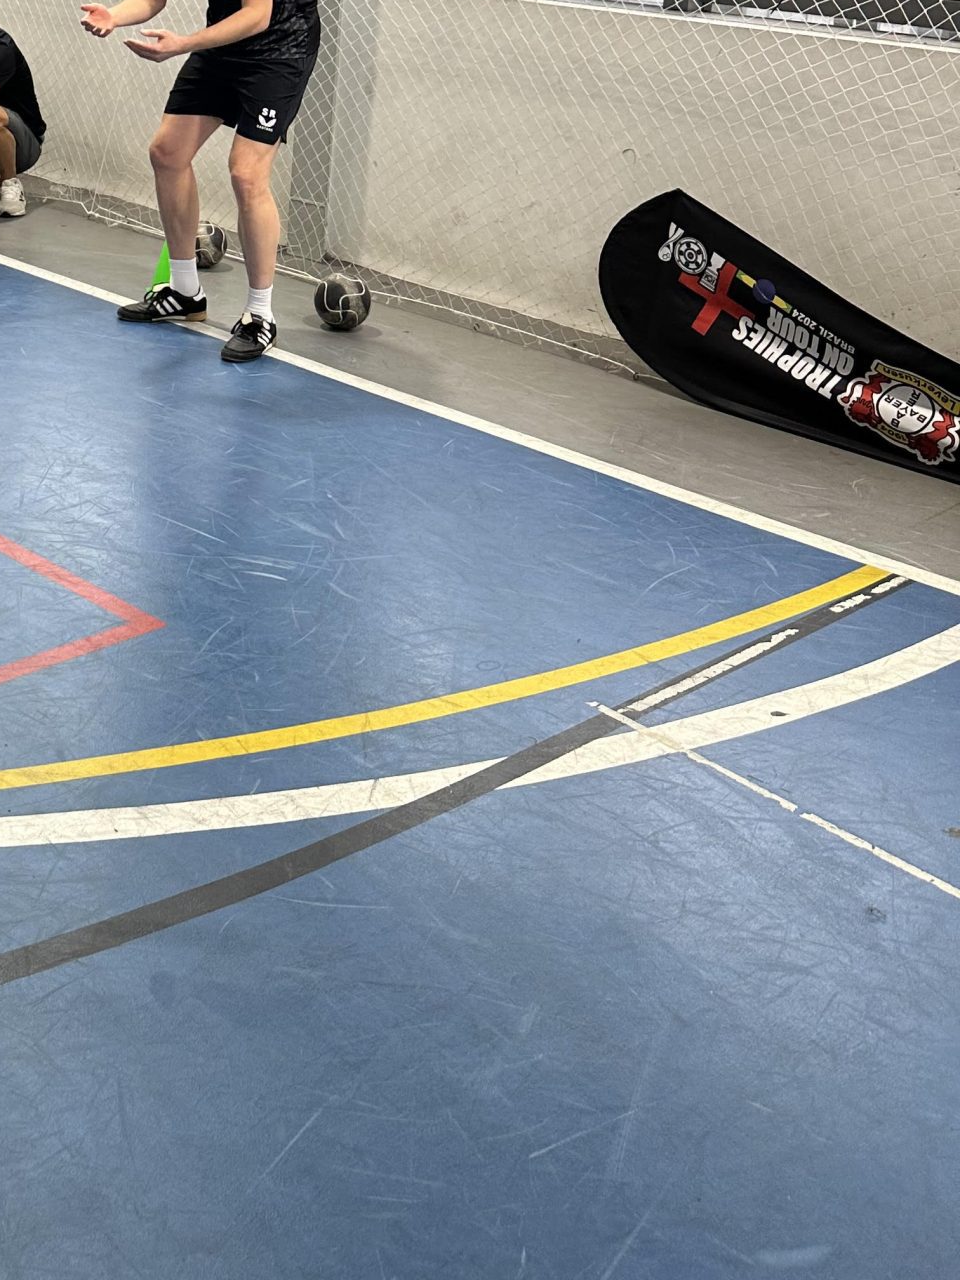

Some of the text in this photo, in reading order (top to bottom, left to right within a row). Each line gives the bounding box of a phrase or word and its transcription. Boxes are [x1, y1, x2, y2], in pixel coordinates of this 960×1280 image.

[766, 306, 855, 376] ON TOUR
[791, 308, 856, 354] BRAZIL 2024
[731, 315, 843, 400] TROPHIES
[882, 365, 957, 410] Leverkusen
[884, 394, 928, 424] BAYER
[890, 389, 921, 428] BAYER
[880, 424, 906, 442] 1904
